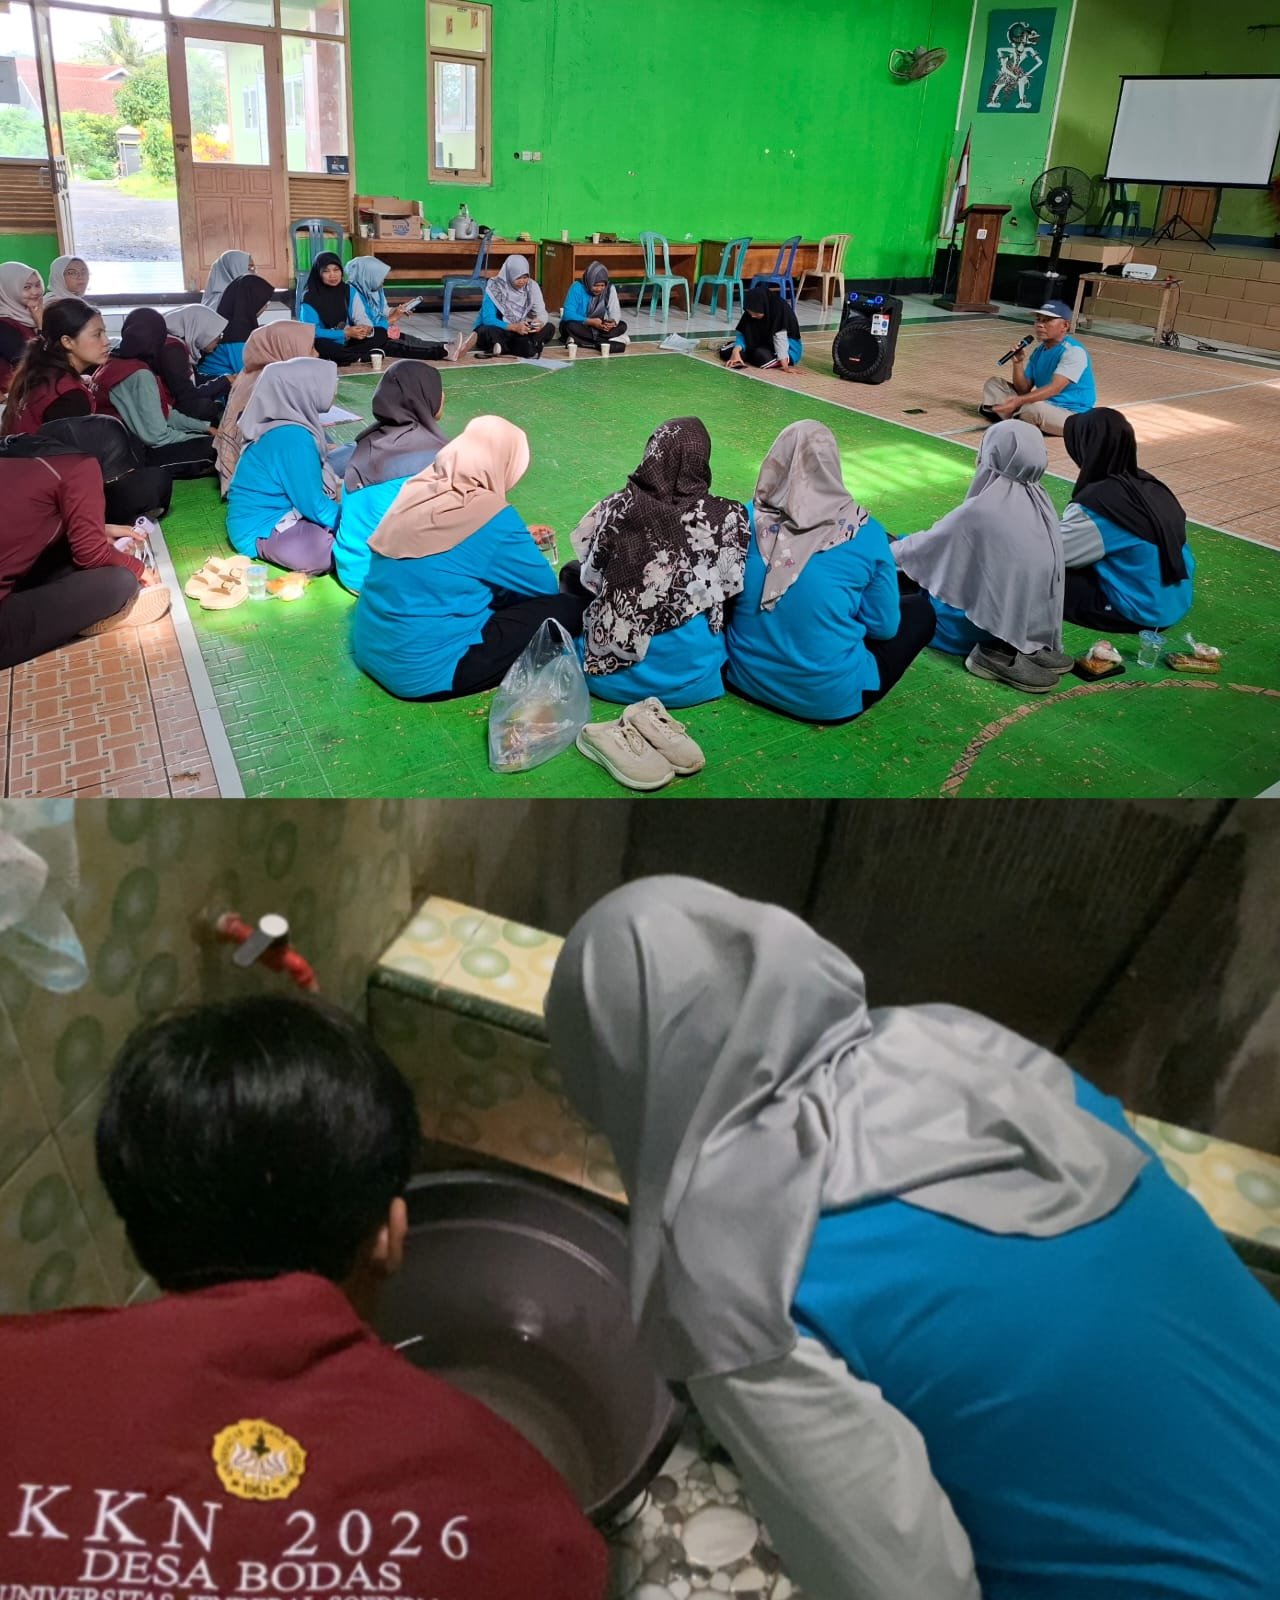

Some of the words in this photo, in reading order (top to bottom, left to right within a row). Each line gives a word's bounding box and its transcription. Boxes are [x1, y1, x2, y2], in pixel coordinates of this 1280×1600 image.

[8, 1483, 223, 1552] KKN
[281, 1509, 469, 1560] 2026
[77, 1548, 219, 1590] DESA
[235, 1560, 403, 1592] BODAS
